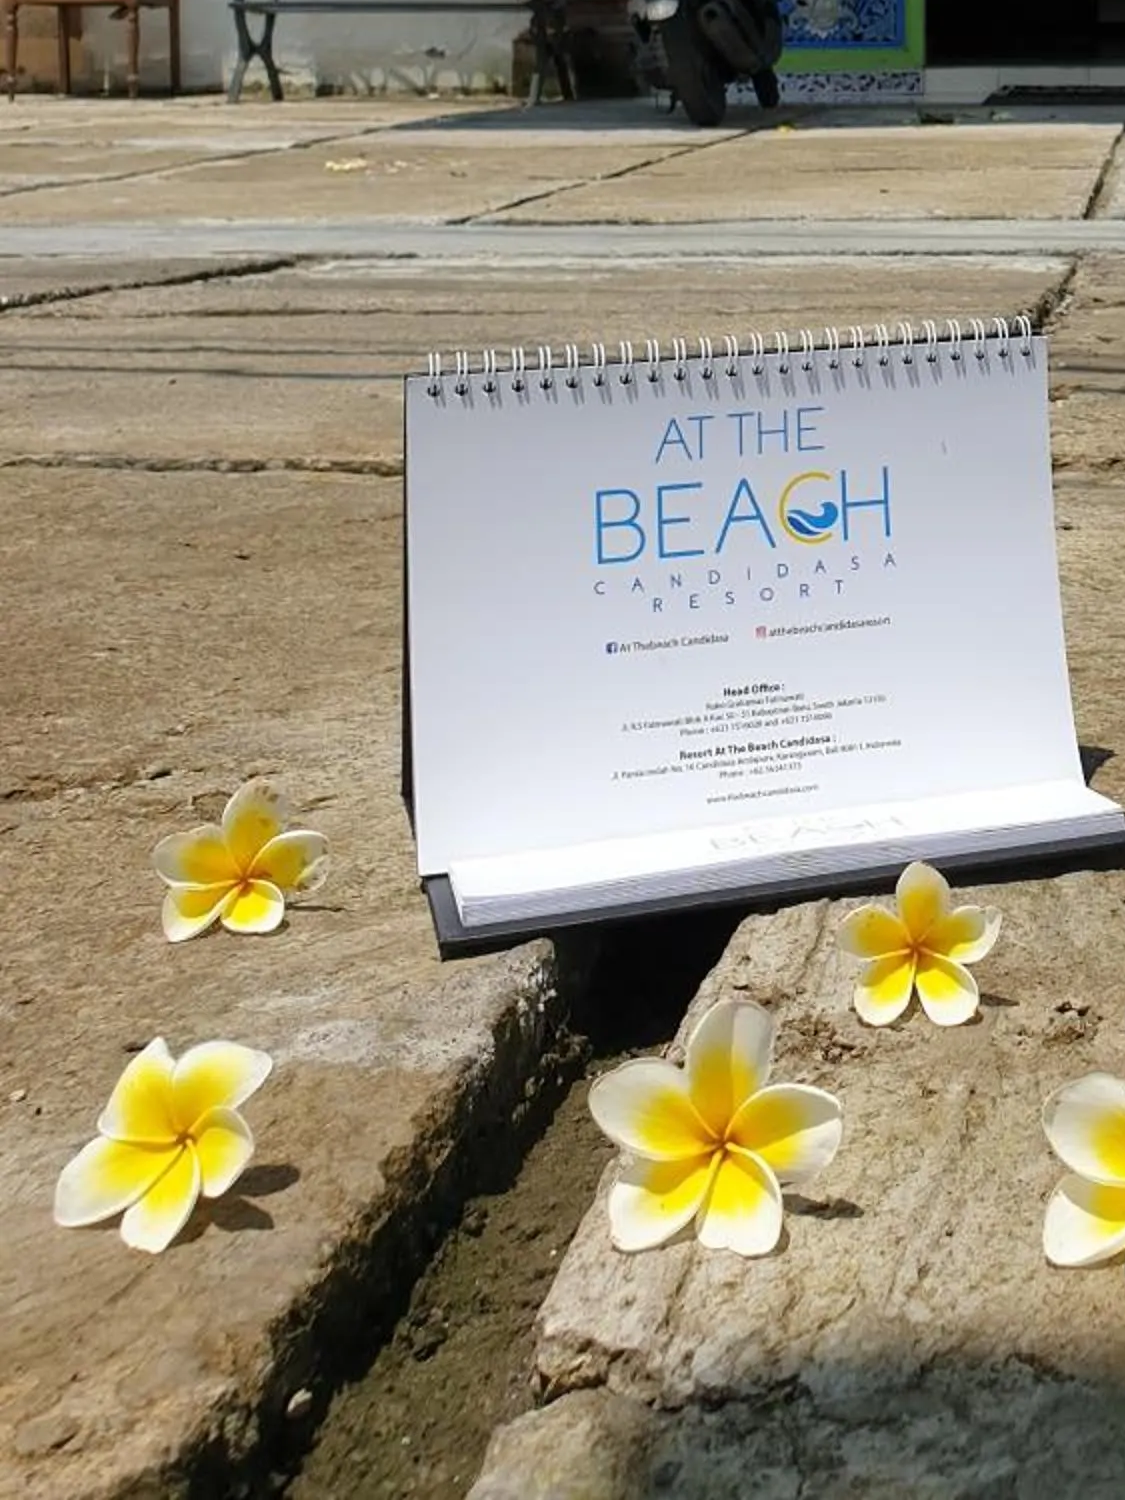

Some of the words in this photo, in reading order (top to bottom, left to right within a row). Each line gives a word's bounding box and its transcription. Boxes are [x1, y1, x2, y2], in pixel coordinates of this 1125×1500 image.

[655, 414, 714, 464] AT
[728, 407, 825, 457] THE
[595, 466, 893, 565] BEACH
[594, 553, 898, 596] CANDIDASA
[652, 580, 845, 613] RESORT
[723, 685, 750, 697] Head
[751, 683, 780, 694] Office
[679, 748, 713, 761] Resort
[715, 746, 726, 756] At
[727, 743, 746, 755] The
[747, 739, 778, 753] Beach
[780, 735, 830, 749] Candidasa
